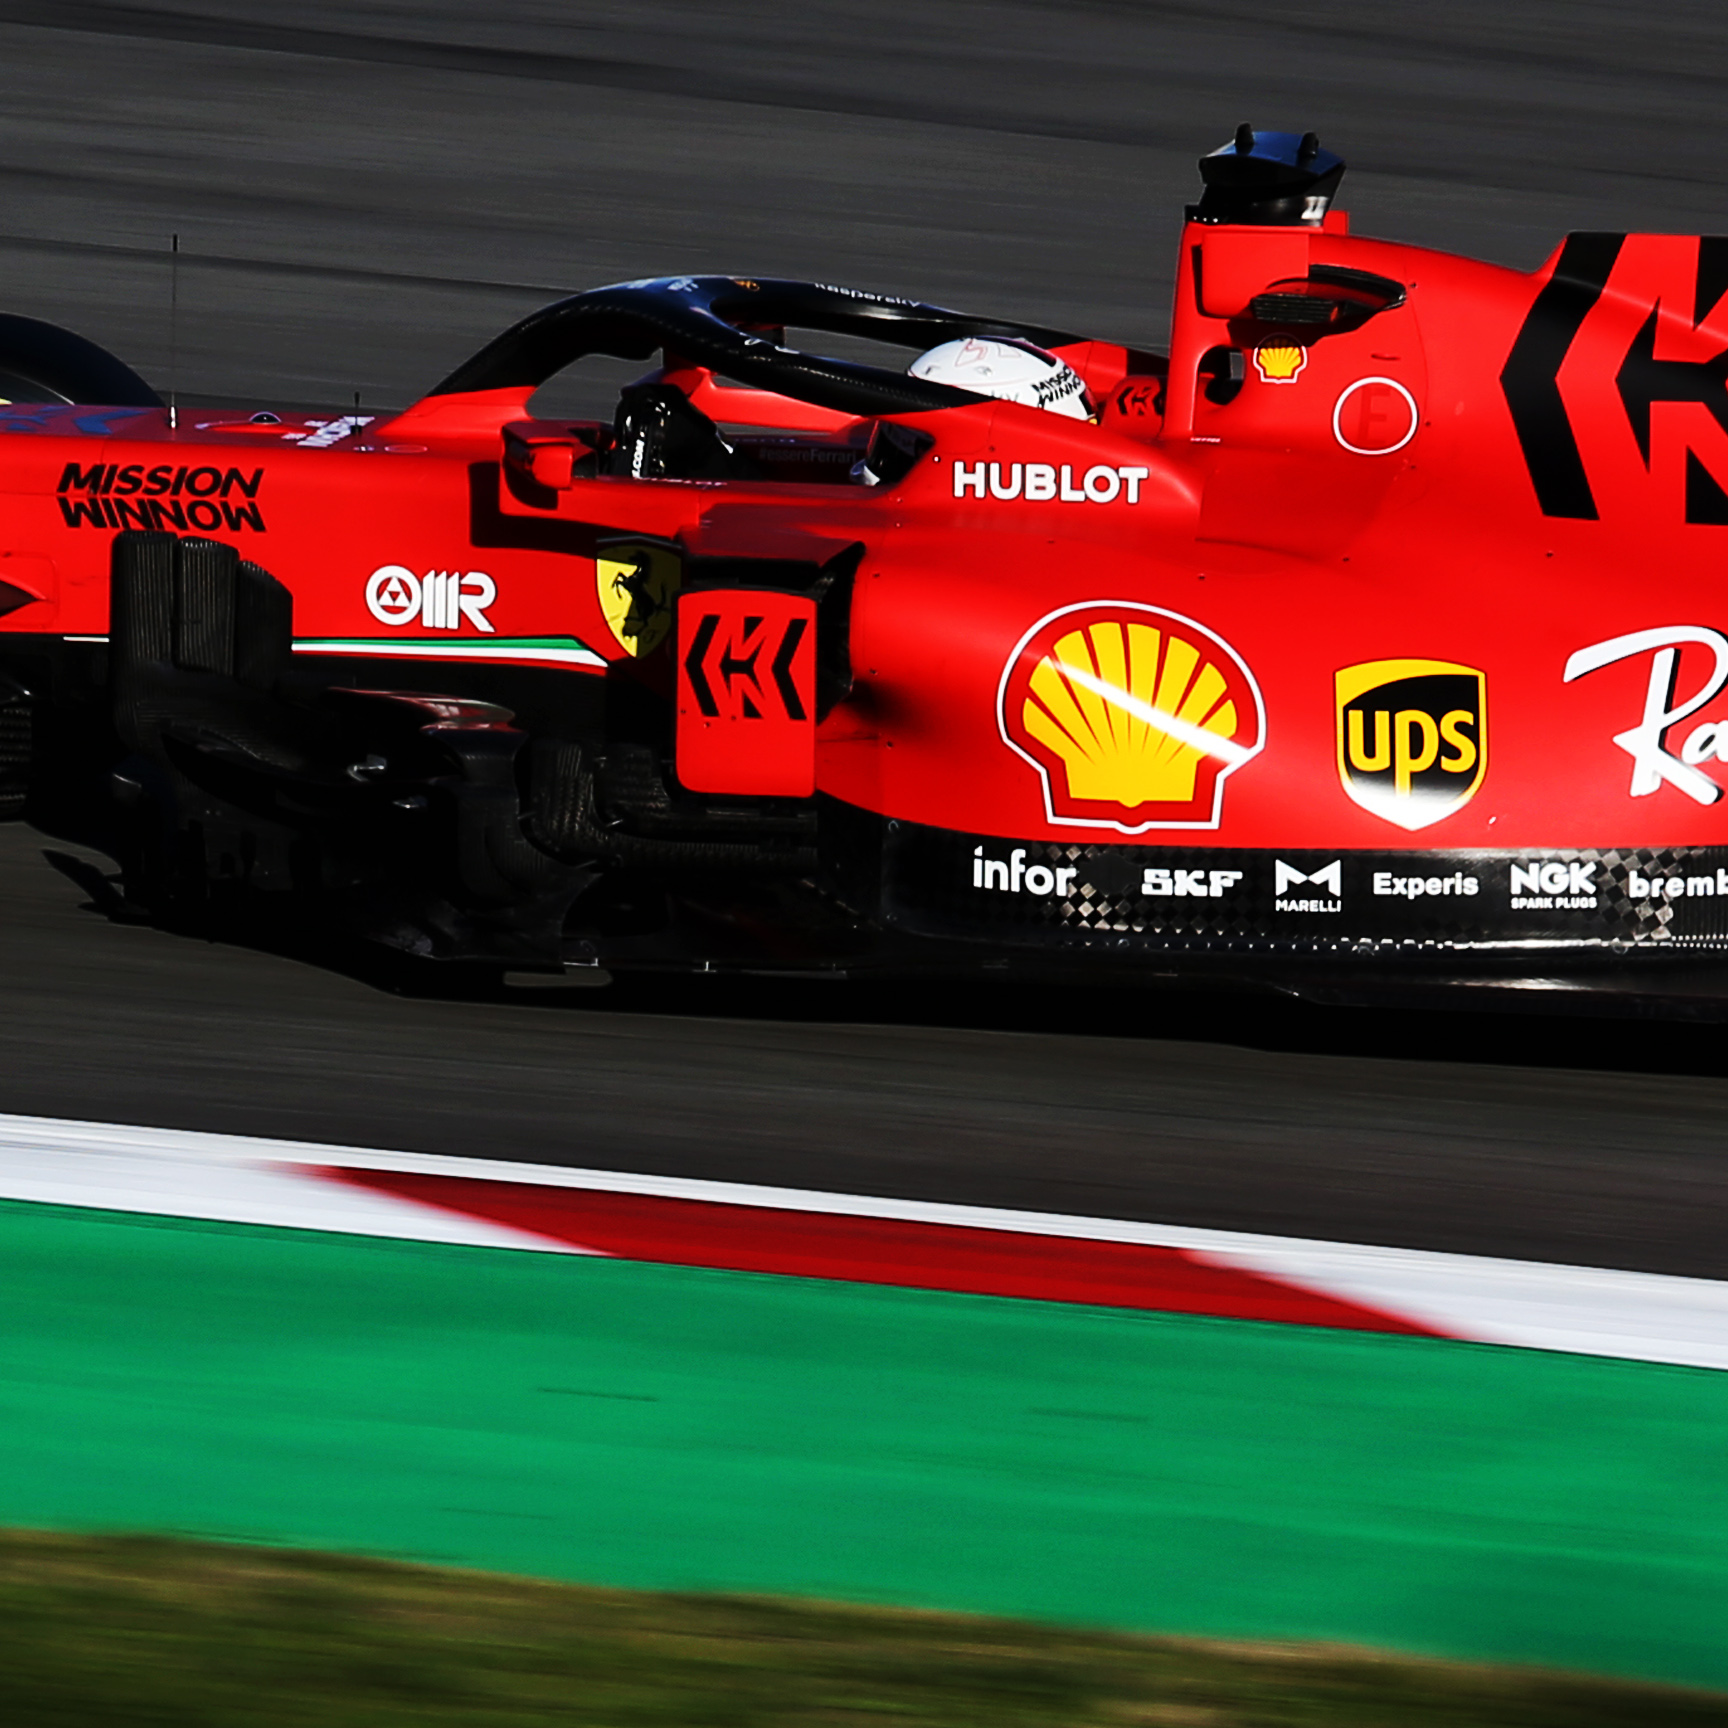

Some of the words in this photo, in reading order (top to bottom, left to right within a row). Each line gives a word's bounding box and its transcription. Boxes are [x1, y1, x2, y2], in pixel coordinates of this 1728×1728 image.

[57, 462, 264, 498] MISSION
[952, 461, 1150, 504] HUBLOT
[57, 497, 266, 532] WINNOW
[1349, 708, 1478, 802] ups
[973, 845, 1077, 897] infor
[1141, 868, 1243, 898] SKF
[1373, 871, 1480, 899] Experis
[1510, 862, 1598, 895] NGK
[1275, 899, 1342, 913] MARELLI
[1511, 896, 1552, 910] SPARK
[1555, 896, 1599, 910] PLUGS
